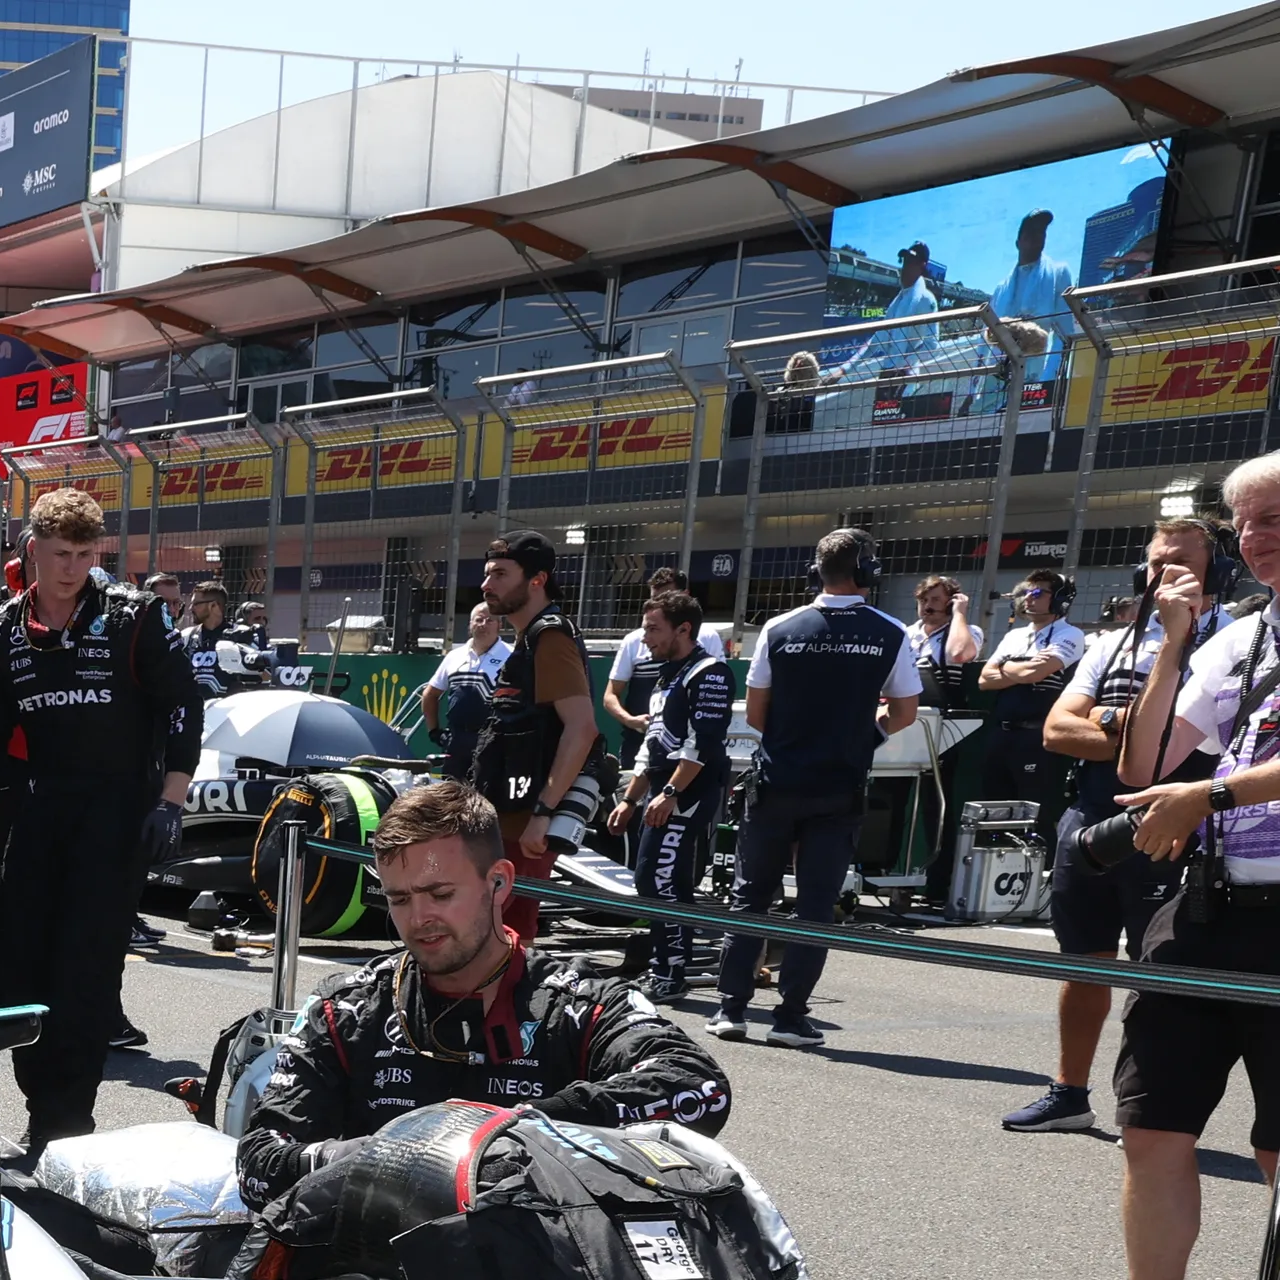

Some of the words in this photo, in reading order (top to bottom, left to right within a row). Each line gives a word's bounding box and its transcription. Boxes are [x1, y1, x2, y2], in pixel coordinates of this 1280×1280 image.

[33, 109, 70, 134] aramco
[33, 164, 57, 186] MSC
[526, 417, 666, 463] DHL
[323, 440, 432, 482] DHL
[161, 462, 246, 496] DHL
[15, 656, 32, 669] UBS
[77, 648, 111, 659] INEOS
[805, 643, 883, 657] ALPHATAURI
[488, 1078, 543, 1097] INEOS
[635, 1240, 661, 1267] 17
[655, 1238, 677, 1266] DRY
[666, 1226, 695, 1275] George
